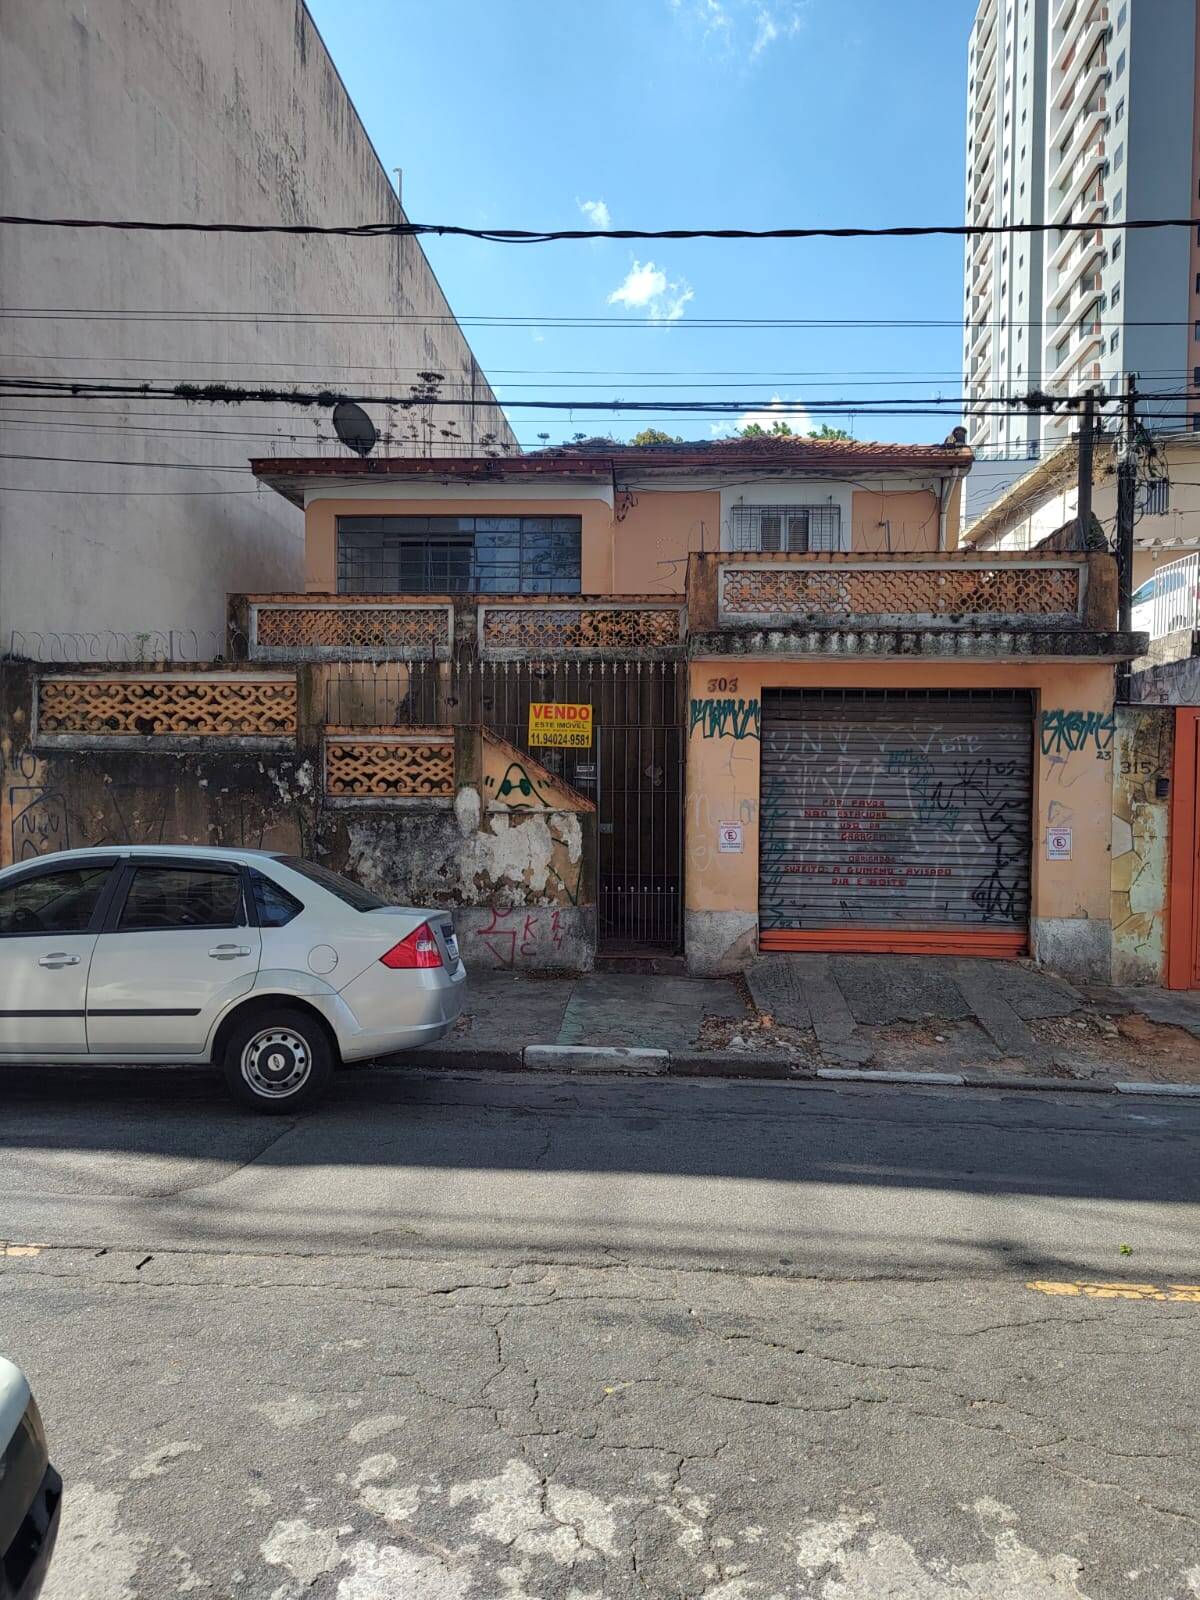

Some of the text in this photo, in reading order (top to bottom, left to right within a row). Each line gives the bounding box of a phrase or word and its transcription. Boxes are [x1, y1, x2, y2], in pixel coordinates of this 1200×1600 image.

[707, 677, 738, 693] 303
[532, 704, 590, 720] VENDO
[1120, 761, 1152, 775] 315
